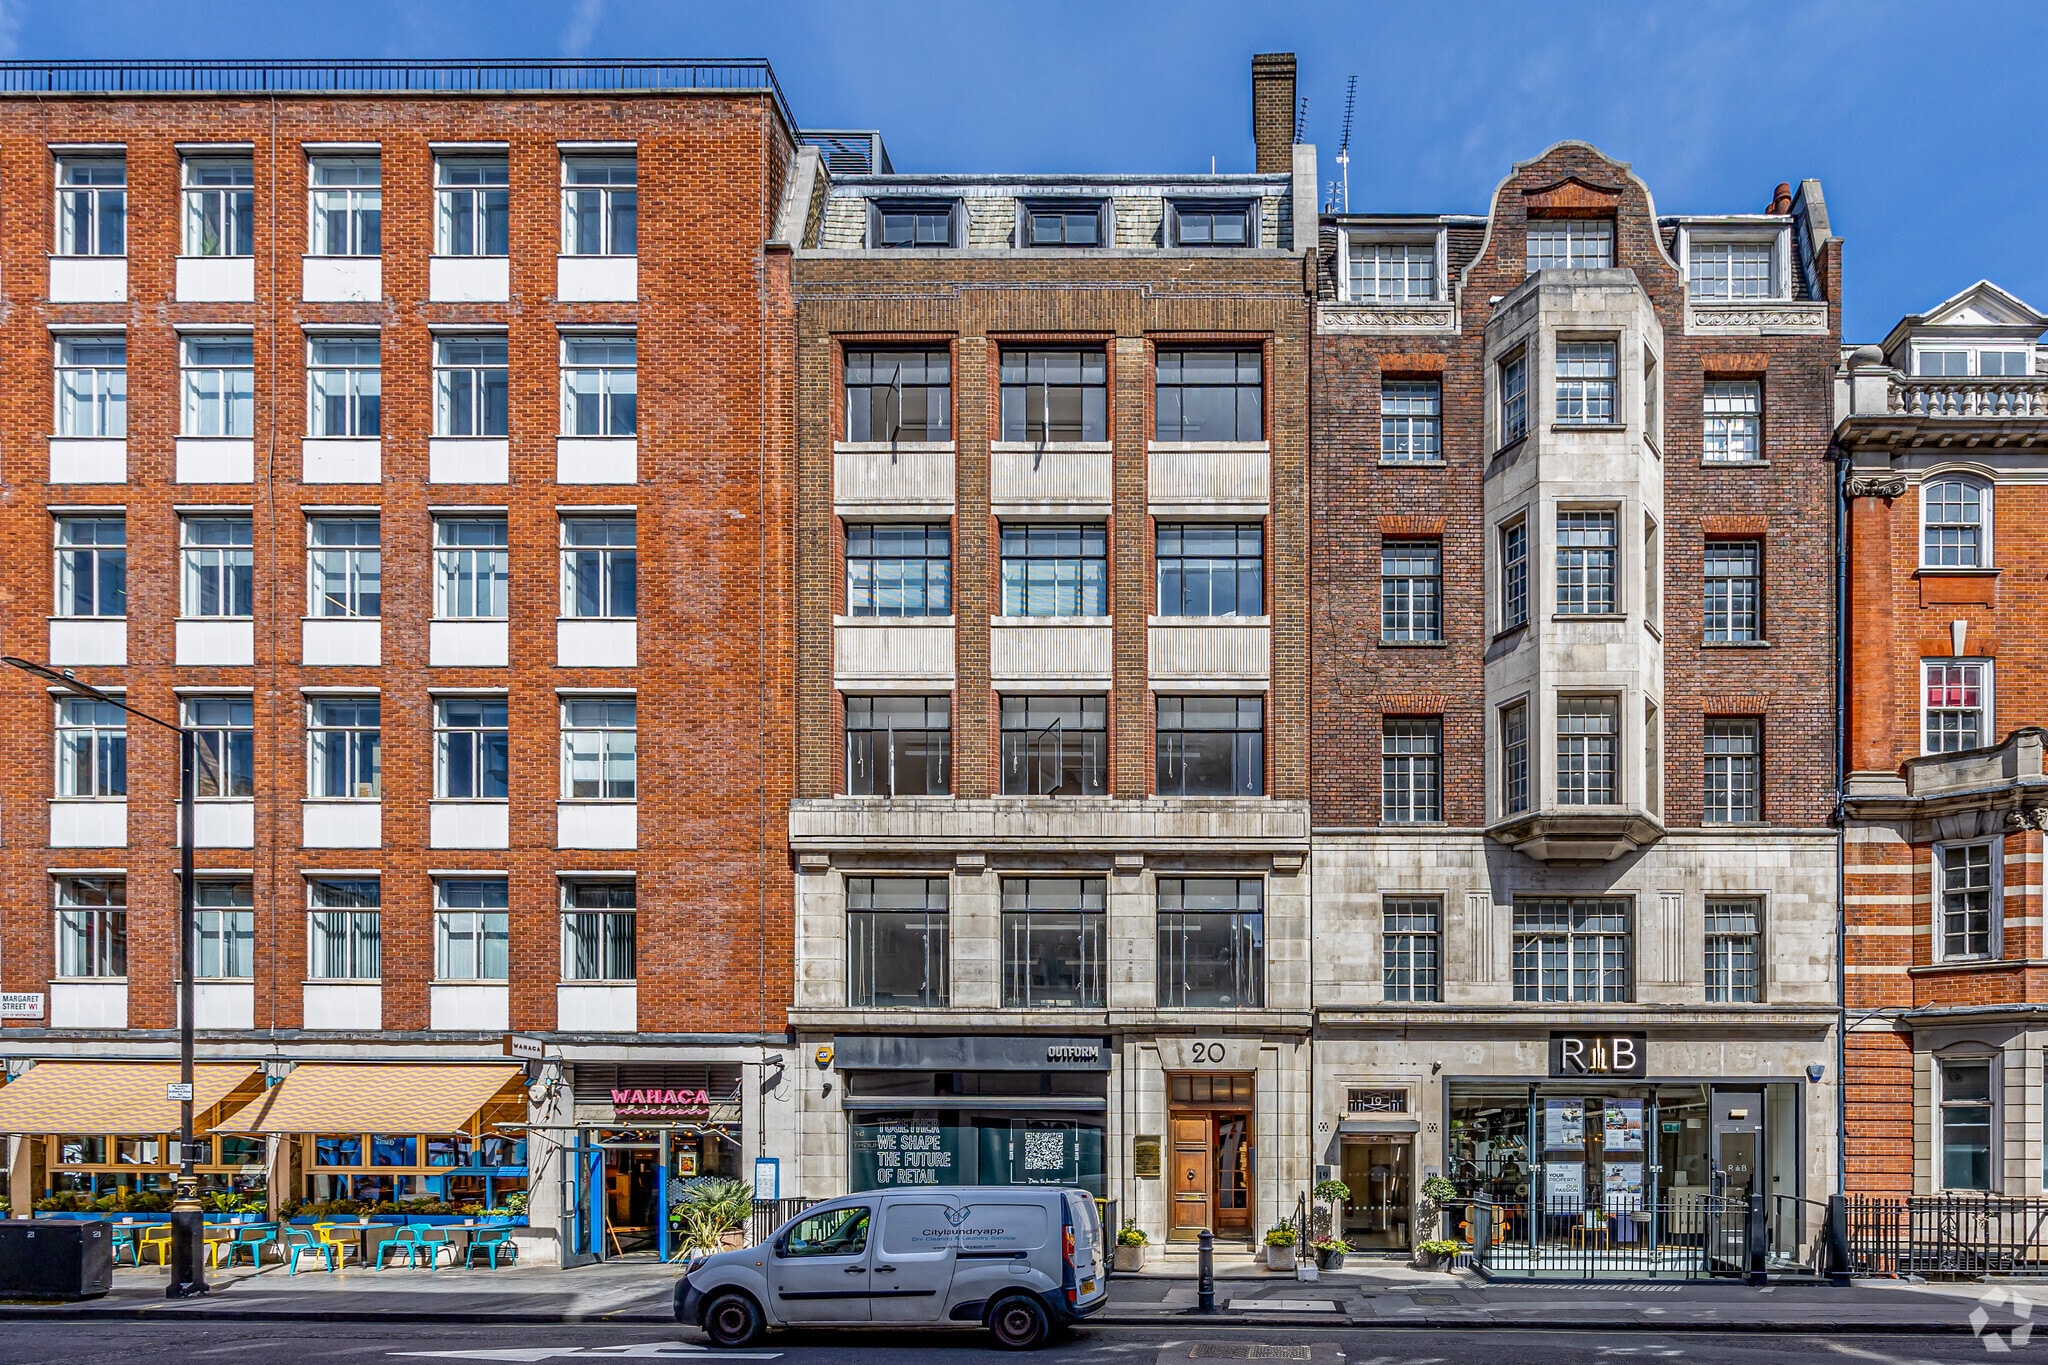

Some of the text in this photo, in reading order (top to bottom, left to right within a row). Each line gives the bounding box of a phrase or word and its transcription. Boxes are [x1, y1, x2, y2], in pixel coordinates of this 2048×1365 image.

[513, 1043, 541, 1052] WAHACA
[1048, 1046, 1099, 1057] OUTFORM
[1192, 1042, 1226, 1063] 20
[611, 1089, 710, 1104] WAHACA
[1371, 1096, 1382, 1106] 19
[877, 1117, 940, 1134] TOGETHER
[877, 1134, 941, 1150] WE SHAPE
[877, 1151, 951, 1167] THE FUTURE
[877, 1168, 939, 1184] OF RETAIL
[1319, 1171, 1328, 1180] 19
[922, 1228, 1004, 1236] Citylaundryapp
